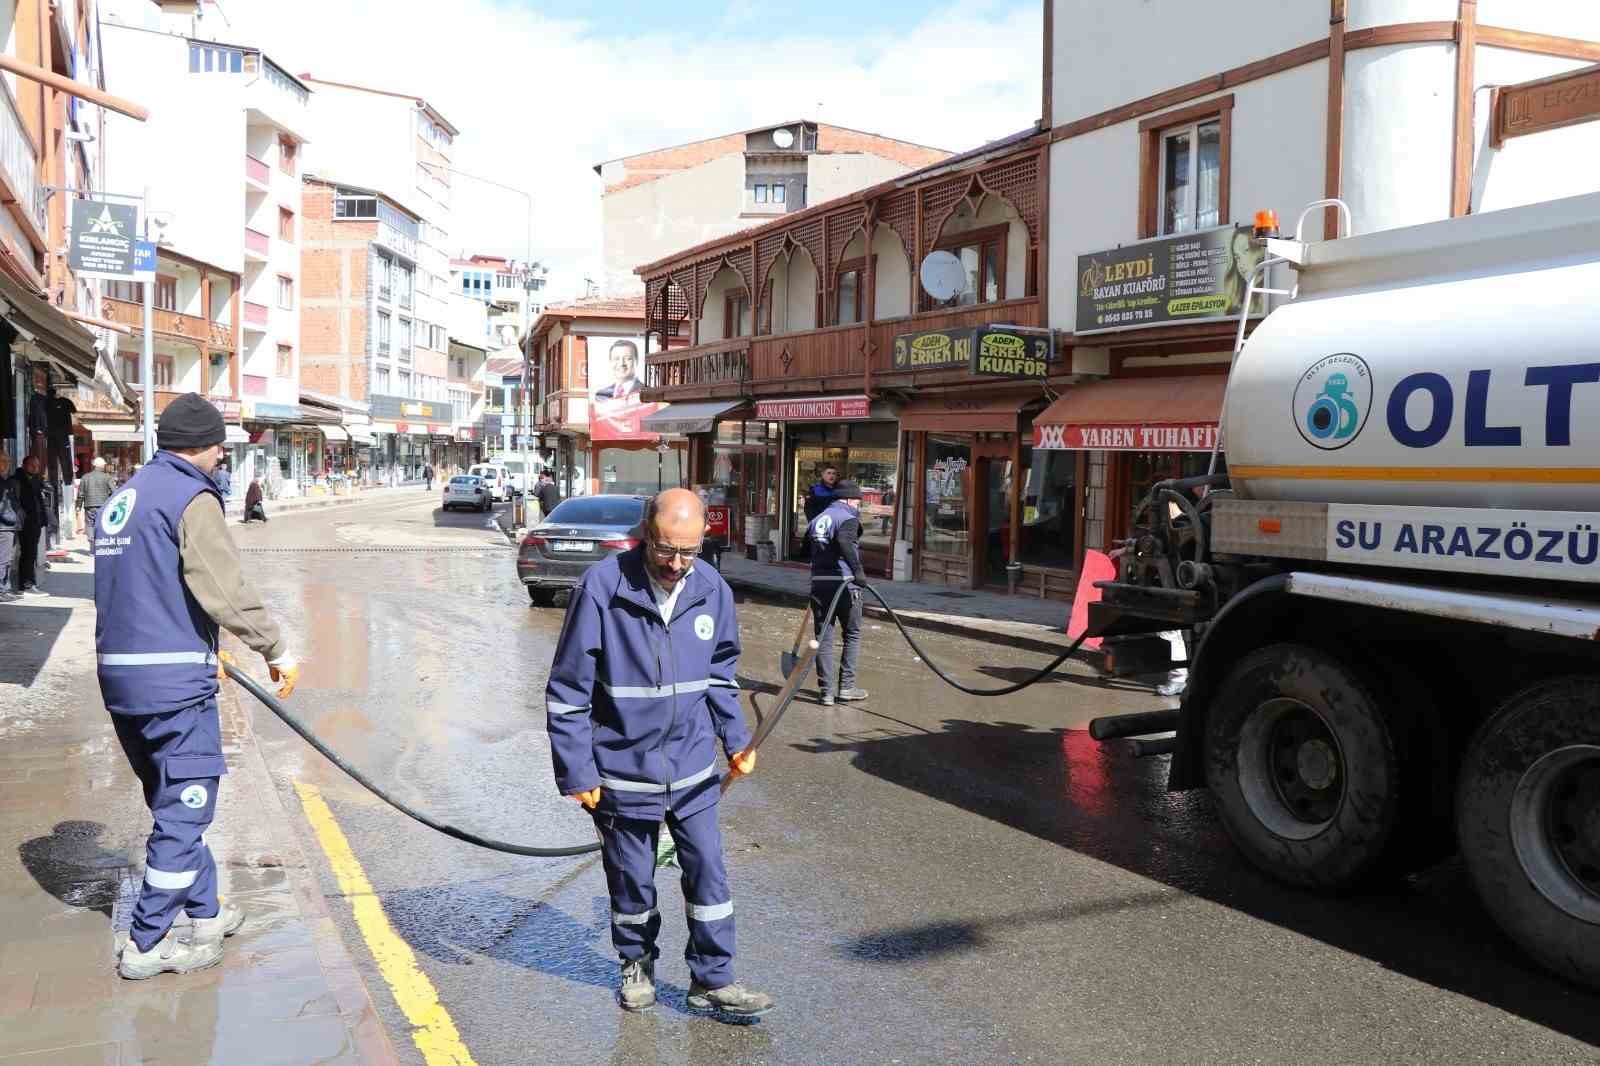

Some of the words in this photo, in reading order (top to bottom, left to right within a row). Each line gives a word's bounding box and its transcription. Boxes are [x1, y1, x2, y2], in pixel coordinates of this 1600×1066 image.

[1105, 252, 1153, 282] LEYDİ
[1093, 284, 1121, 299] BAYAN
[1122, 275, 1167, 296] KUAFÖRÜ
[1171, 302, 1190, 312] LAZER
[992, 335, 1015, 344] ADEM
[911, 344, 951, 365] ERKEK
[980, 343, 1025, 358] ERKEK
[979, 357, 1047, 376] KUAFÖR
[758, 404, 788, 418] KANAAT
[788, 401, 836, 417] KUYUMCUSU
[1386, 363, 1600, 449] OLT
[1080, 427, 1135, 447] YAREN
[1335, 519, 1382, 551] SU
[1393, 521, 1599, 566] ARAZÖZÜ
